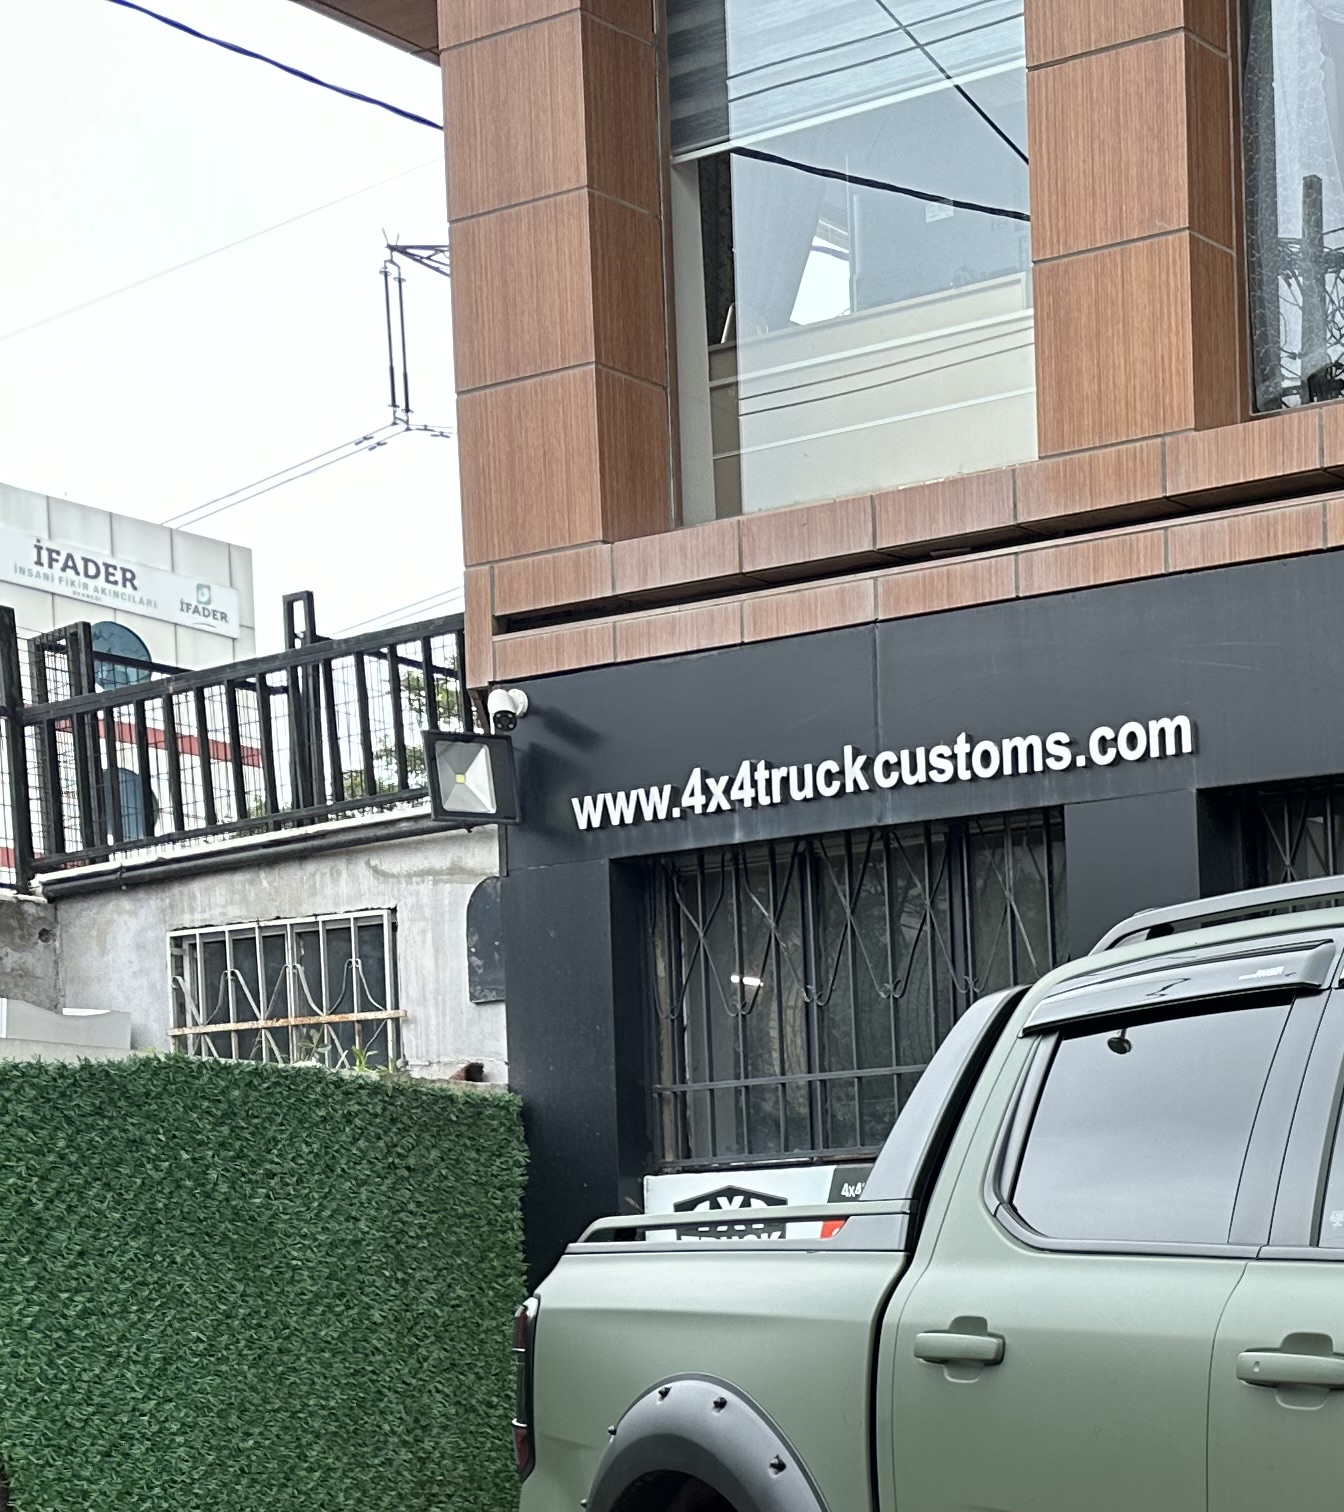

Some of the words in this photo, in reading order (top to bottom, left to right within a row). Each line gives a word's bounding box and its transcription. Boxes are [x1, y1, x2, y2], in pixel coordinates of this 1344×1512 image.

[33, 538, 138, 591] İFADER
[93, 584, 158, 609] AKINCILARI
[179, 597, 229, 624] İFADER
[571, 713, 1194, 831] www.4x4truckcustoms.com
